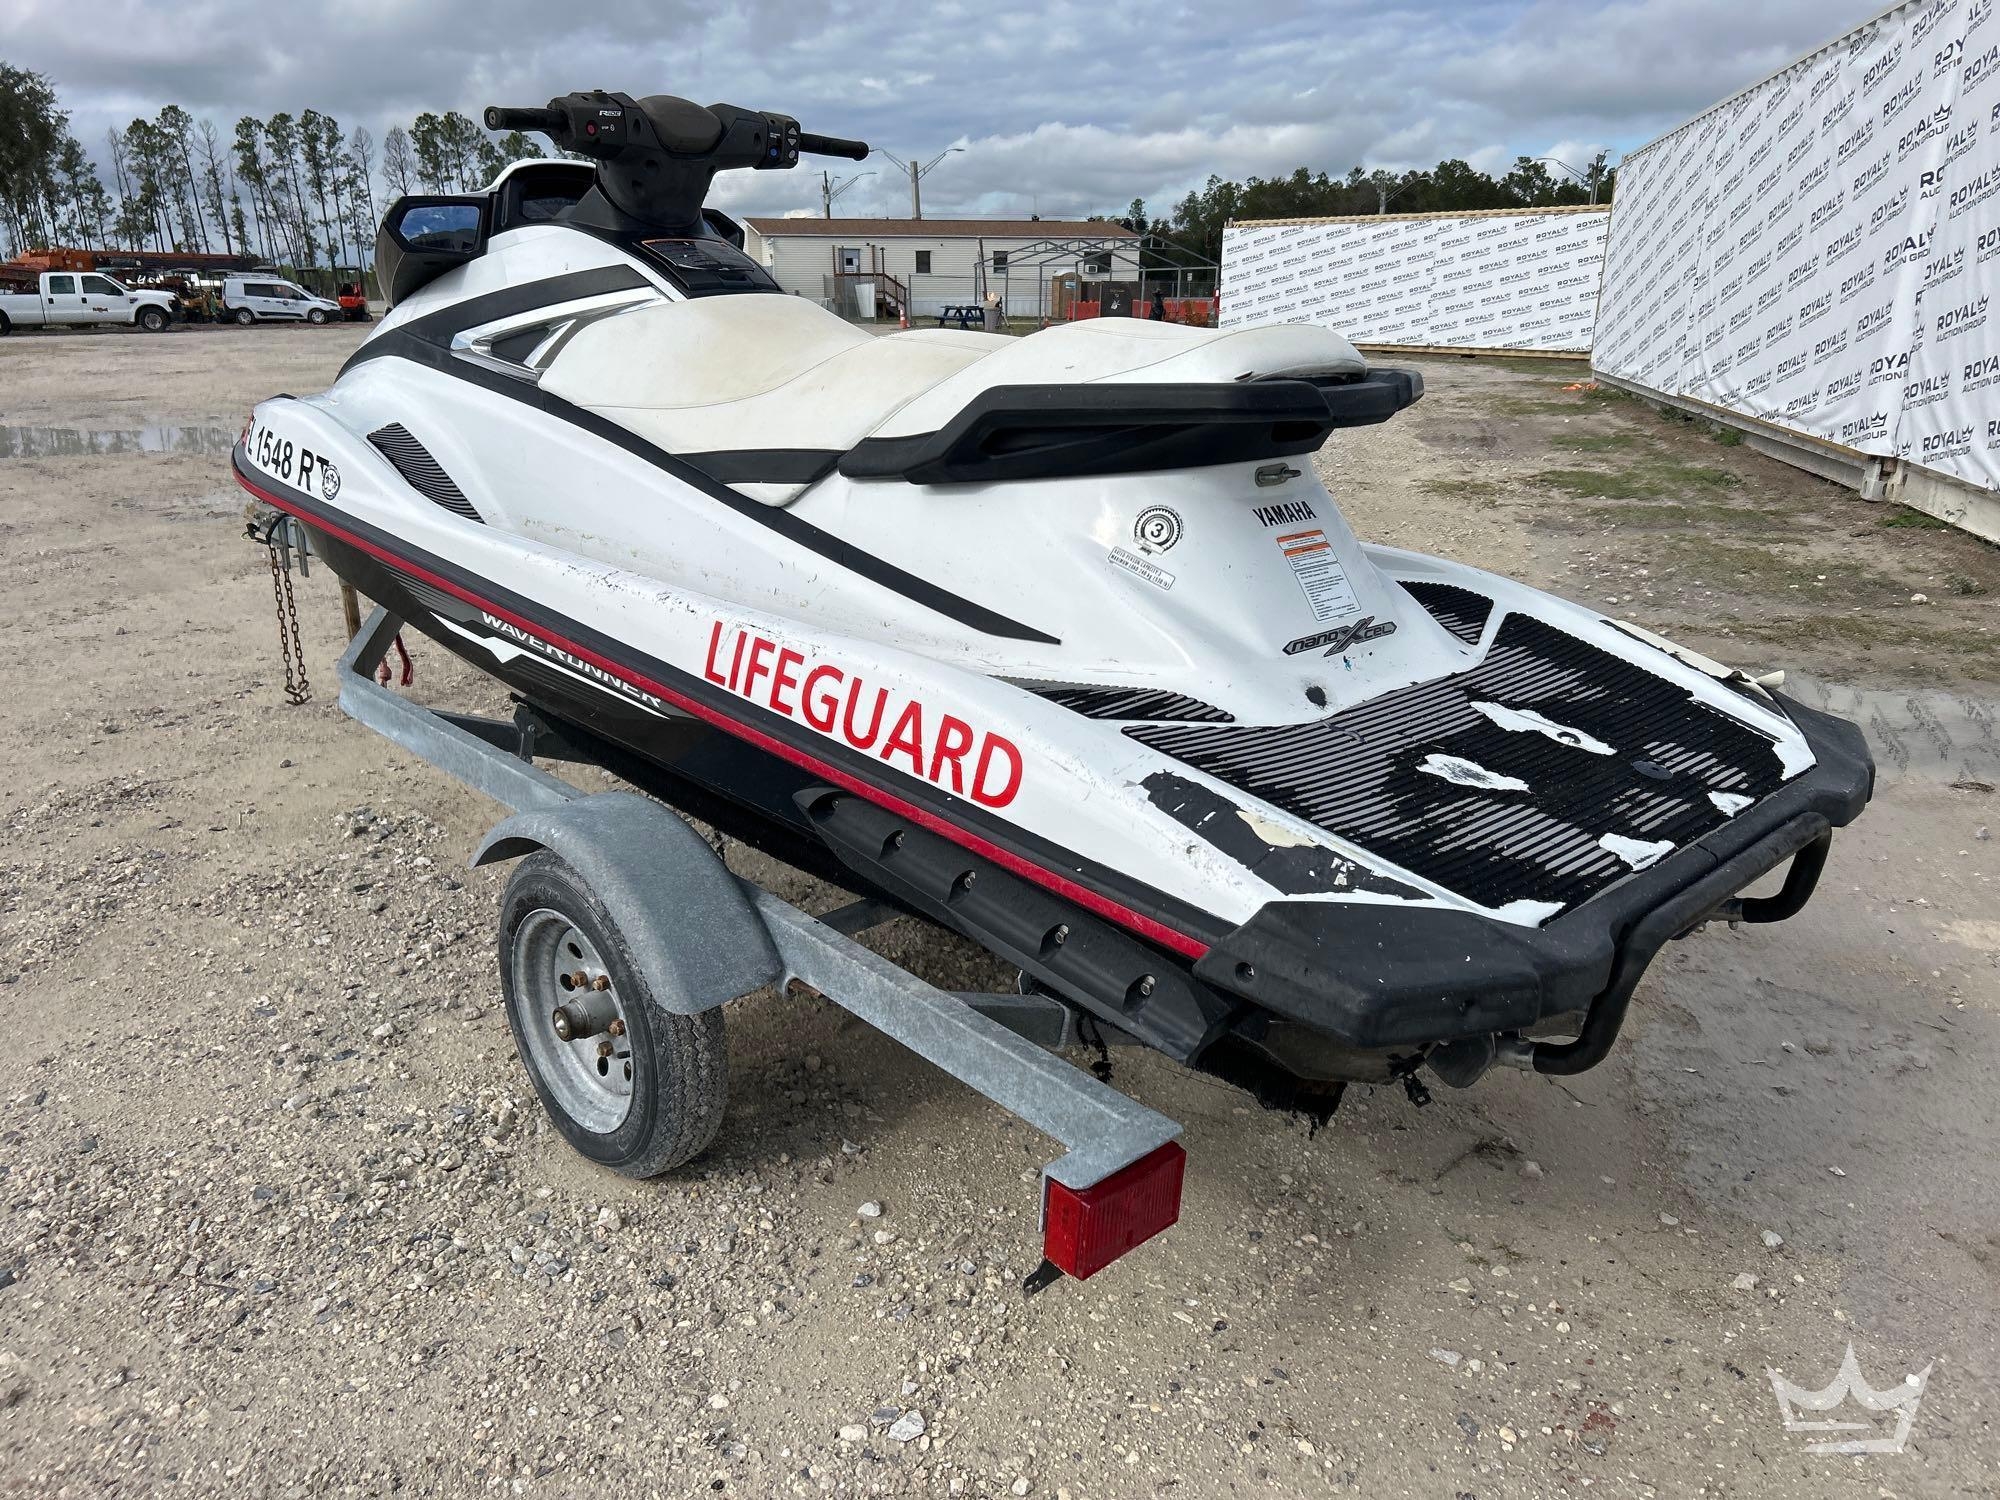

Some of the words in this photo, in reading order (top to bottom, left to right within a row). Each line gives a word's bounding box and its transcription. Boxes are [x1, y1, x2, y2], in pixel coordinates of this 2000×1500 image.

[1863, 51, 1893, 89] ROYAL
[1811, 68, 1834, 99] ROYAL
[1883, 79, 1914, 118] ROYAL
[1779, 106, 1798, 135] ROYAL
[1822, 97, 1846, 130] ROYAL
[1788, 135, 1808, 164] ROYAL
[1837, 126, 1865, 158] ROYAL
[1758, 170, 1776, 194] ROYAL
[1800, 164, 1823, 192] ROYAL
[1854, 160, 1881, 192] ROYAL
[1950, 172, 1991, 209] ROYAL
[1769, 197, 1788, 221] ROYAL
[1811, 197, 1836, 224] ROYAL
[1405, 220, 1428, 230] ROYAL
[1515, 217, 1539, 227] ROYAL
[1577, 218, 1603, 228] ROYAL
[1477, 227, 1502, 238] ROYAL
[1536, 228, 1561, 239] ROYAL
[1778, 228, 1797, 252] ROYAL
[1391, 241, 1413, 250] ROYAL
[1441, 238, 1465, 247] ROYAL
[1498, 238, 1523, 248] ROYAL
[1556, 241, 1581, 251] ROYAL
[1827, 229, 1854, 258] ROYAL
[1884, 233, 1926, 264] ROYAL
[1407, 252, 1430, 261] ROYAL
[1461, 249, 1485, 258] ROYAL
[1516, 251, 1541, 261] ROYAL
[1578, 253, 1604, 263] ROYAL
[1443, 270, 1467, 279] ROYAL
[1479, 261, 1504, 270] ROYAL
[1538, 263, 1563, 273] ROYAL
[1748, 254, 1767, 277] ROYAL
[1788, 260, 1811, 284] ROYAL
[1393, 272, 1415, 281] ROYAL
[1500, 272, 1525, 282] ROYAL
[1557, 275, 1583, 286] ROYAL
[1463, 281, 1487, 291] ROYAL
[1518, 285, 1543, 295] ROYAL
[1377, 292, 1400, 301] ROYAL
[1481, 294, 1506, 303] ROYAL
[1540, 297, 1565, 307] ROYAL
[1758, 285, 1777, 307] ROYAL
[1395, 303, 1418, 312] ROYAL
[1445, 302, 1469, 311] ROYAL
[1501, 306, 1526, 315] ROYAL
[1559, 310, 1585, 320] ROYAL
[1800, 296, 1825, 320] ROYAL
[1430, 321, 1453, 330] ROYAL
[1465, 314, 1489, 323] ROYAL
[1520, 319, 1545, 328] ROYAL
[1730, 306, 1747, 327] ROYAL
[1857, 306, 1885, 332] ROYAL
[1937, 302, 1977, 331] ROYAL
[1447, 334, 1471, 343] ROYAL
[1483, 326, 1508, 336] ROYAL
[1541, 331, 1566, 340] ROYAL
[1767, 319, 1786, 340] ROYAL
[1503, 339, 1528, 348] ROYAL
[1737, 340, 1757, 359] ROYAL
[1815, 333, 1840, 356] ROYAL
[1777, 354, 1800, 375] ROYAL
[1746, 373, 1766, 391] ROYAL
[1827, 372, 1853, 396] ROYAL
[1903, 376, 1939, 401] ROYAL
[1786, 393, 1812, 413] ROYAL
[1842, 417, 1870, 438] ROYAL
[1923, 430, 1962, 451] ROYAL
[257, 426, 293, 480] 1548
[1252, 500, 1317, 528] YAMAHA
[1150, 522, 1165, 539] 3
[481, 611, 662, 708] WAVERUNNER
[704, 620, 1024, 809] LIFEGUARD
